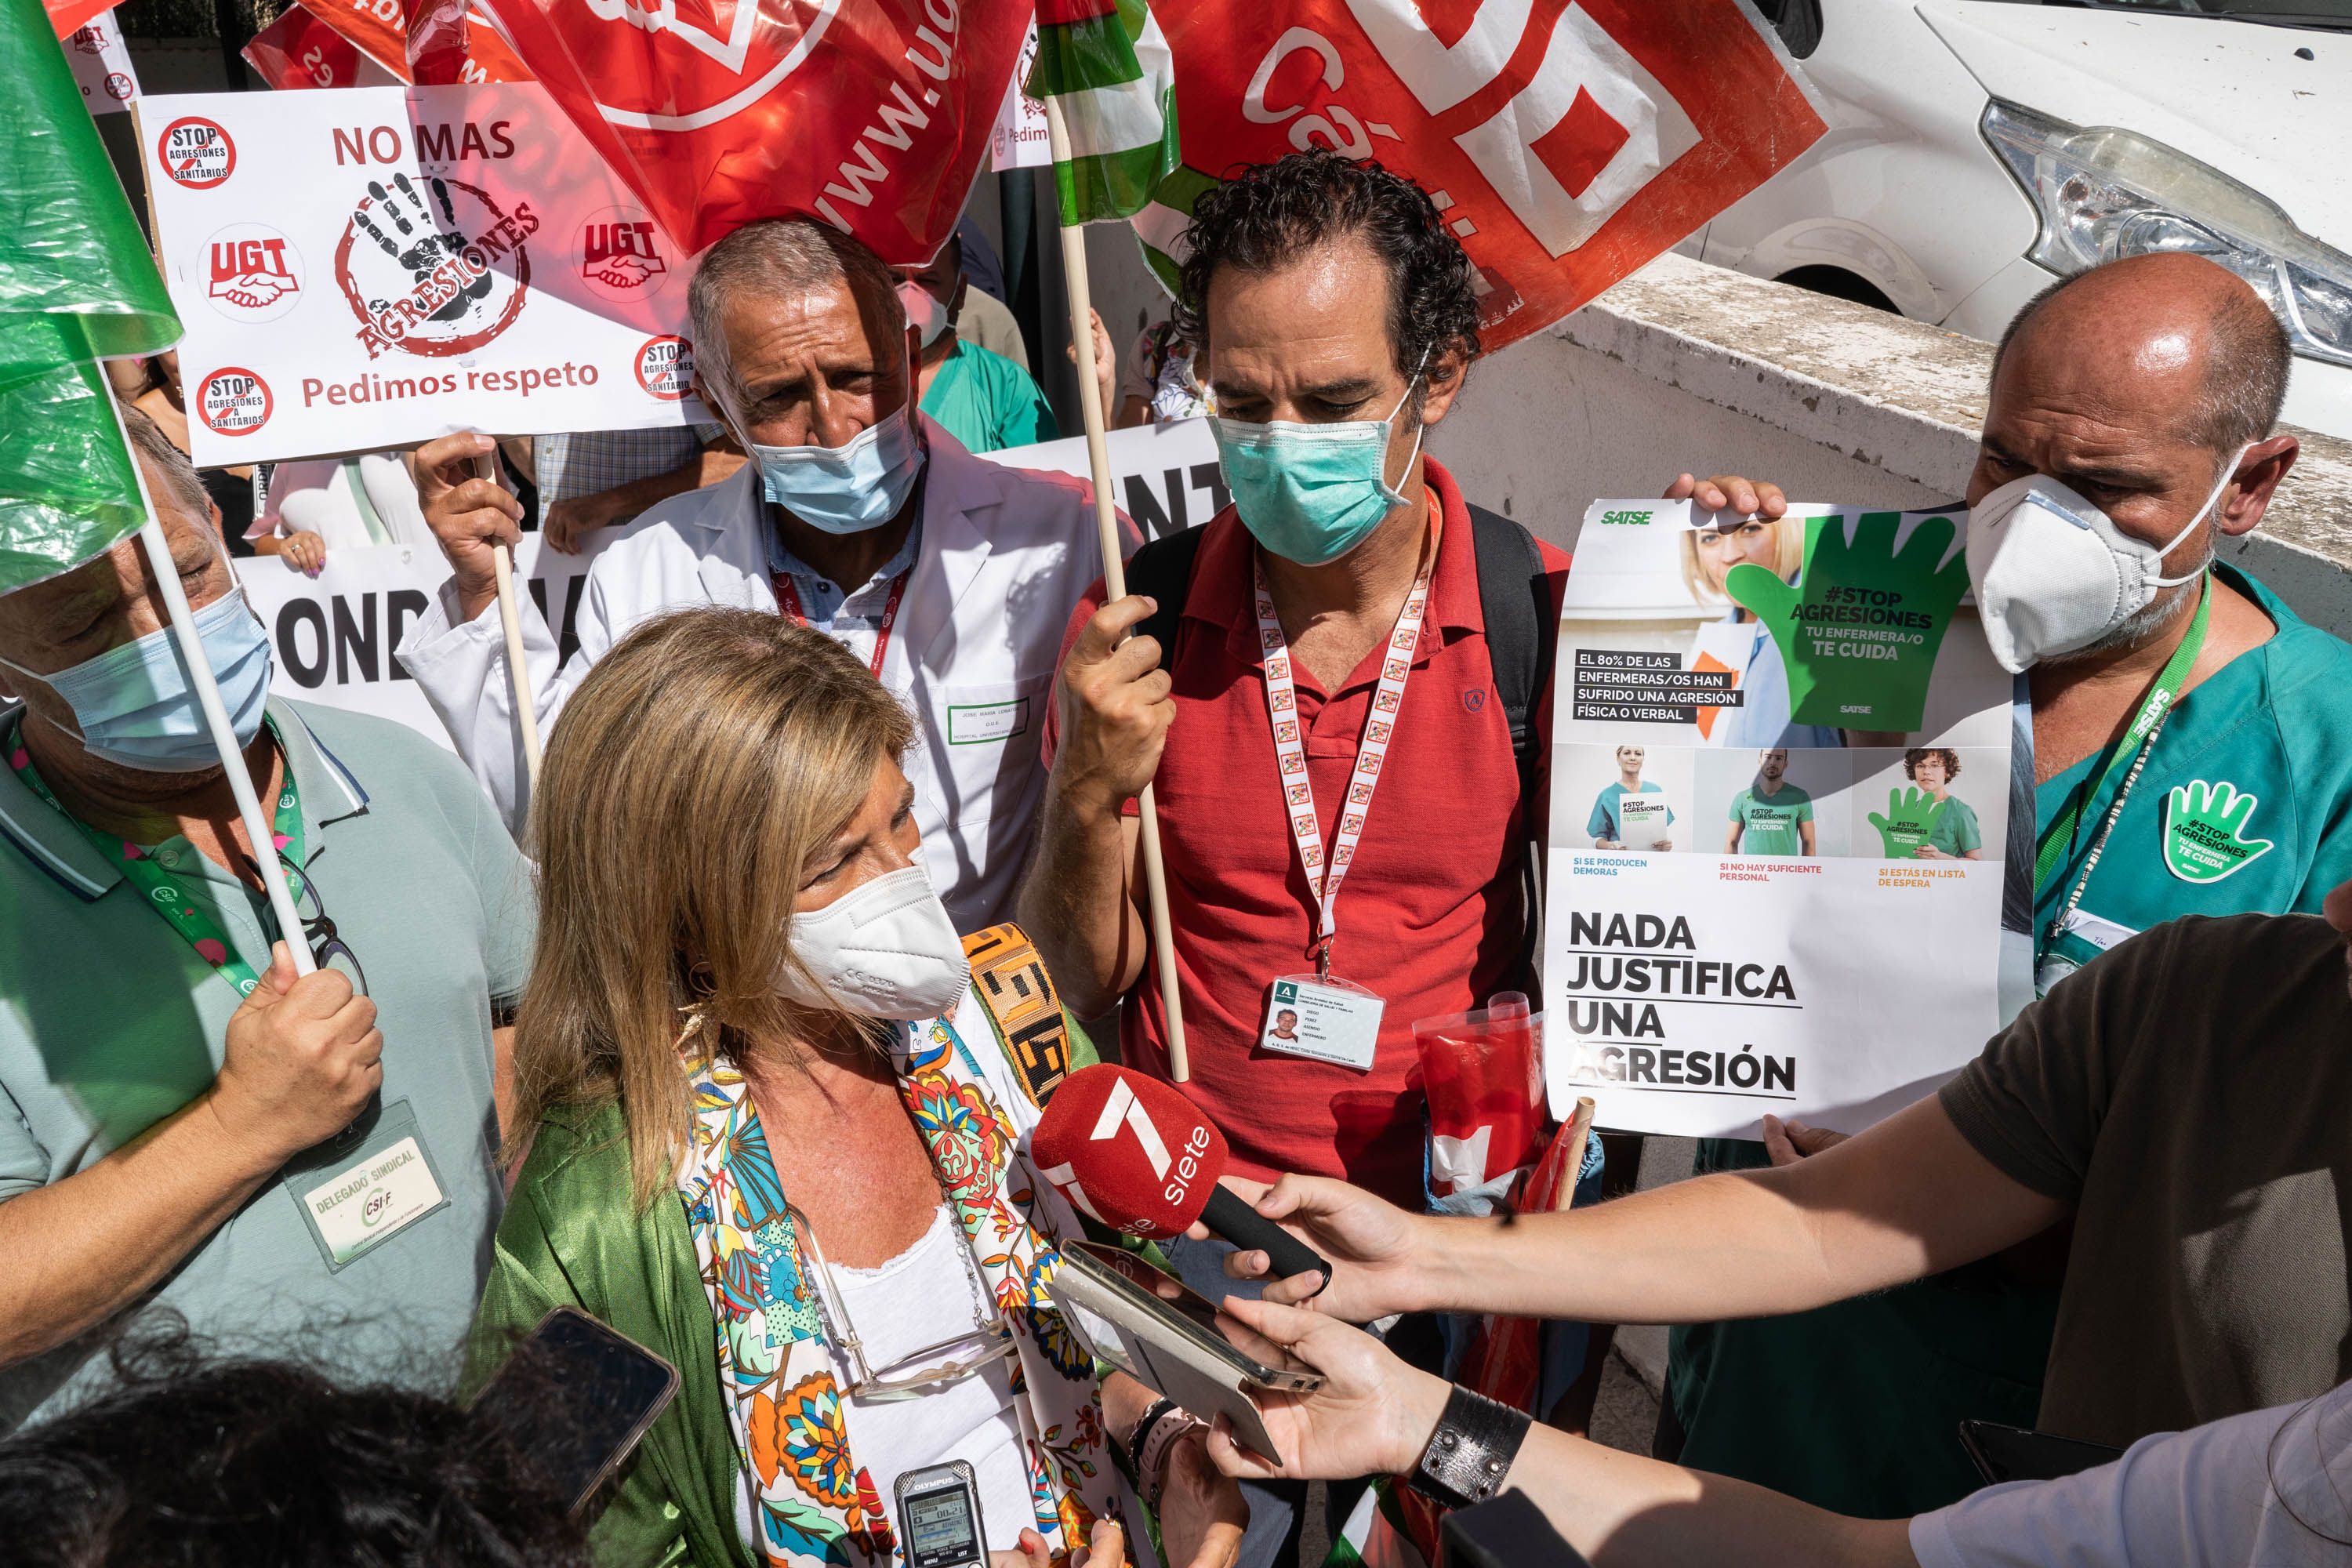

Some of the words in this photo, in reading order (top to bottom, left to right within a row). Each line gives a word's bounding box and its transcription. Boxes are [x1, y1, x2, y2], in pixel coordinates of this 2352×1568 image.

[172, 127, 217, 146] STOP
[332, 126, 402, 165] NO
[416, 121, 515, 162] MAS
[1009, 126, 1047, 143] Pedim
[169, 147, 226, 159] AGRESIONES
[197, 159, 202, 168] A
[174, 168, 227, 179] SANITARIOS
[585, 222, 655, 260] UGT
[210, 238, 287, 281] UGT
[355, 201, 539, 361] AGRESIONES
[647, 343, 687, 361] STOP
[644, 362, 694, 374] AGRESIONES
[211, 378, 255, 397] STOP
[302, 372, 457, 408] Pedimos
[467, 361, 598, 397] respeto
[648, 380, 690, 391] SANITARIO
[208, 397, 263, 408] AGRESIONES
[211, 416, 263, 427] SANITARIOS
[1601, 510, 1653, 525] SATSE
[1825, 586, 1902, 607] #STOP
[1790, 604, 1933, 629] AGRESIONES
[1806, 626, 1822, 637] TU
[1826, 627, 1924, 644] ENFERMERA/O
[1813, 641, 1835, 656] TE
[1838, 643, 1898, 661] CUIDA
[1580, 654, 1595, 665] EL
[1598, 654, 1624, 666] 80%
[1627, 655, 1643, 667] DE
[1646, 656, 1671, 667] LAS
[1579, 671, 1691, 686] ENFERMERAS/OS
[1694, 675, 1722, 686] HAN
[1577, 689, 1634, 702] SUFRIDO
[1638, 691, 1665, 702] UNA
[1669, 690, 1736, 704] AGRESIÓN
[1577, 704, 1617, 718] FÍSICA
[1620, 708, 1630, 718] O
[1634, 708, 1683, 720] VERBAL
[1840, 705, 1871, 713] SATSE
[2133, 688, 2170, 738] SATSE
[1886, 826, 1928, 835] AGRESIONES
[2189, 819, 2230, 840] #STOP
[2172, 824, 2249, 858] AGRESIONES
[2178, 837, 2189, 845] TU
[2188, 841, 2230, 862] ENFERMERA
[1597, 858, 1647, 867] PRODUCEN
[2178, 845, 2193, 857] TE
[2192, 852, 2223, 869] CUIDA
[1573, 867, 1618, 876] DEMORAS
[1719, 873, 1769, 882] PERSONAL
[1767, 865, 1822, 873] SUFICIENTE
[1890, 866, 1920, 877] ESTÁS
[1937, 869, 1965, 878] LISTA
[1893, 879, 1931, 888] ESPERA
[1570, 911, 1697, 950] NADA
[1566, 956, 1796, 1000] JUSTIFICA
[1568, 1000, 1665, 1038] UNA
[1568, 1044, 1795, 1092] AGRESIÓN
[1164, 1126, 1210, 1206] siete
[316, 1177, 368, 1214] DELEGADO
[370, 1150, 415, 1181] SINDICAL
[914, 1477, 954, 1490] OLYMPUS
[924, 1557, 938, 1566] MENU
